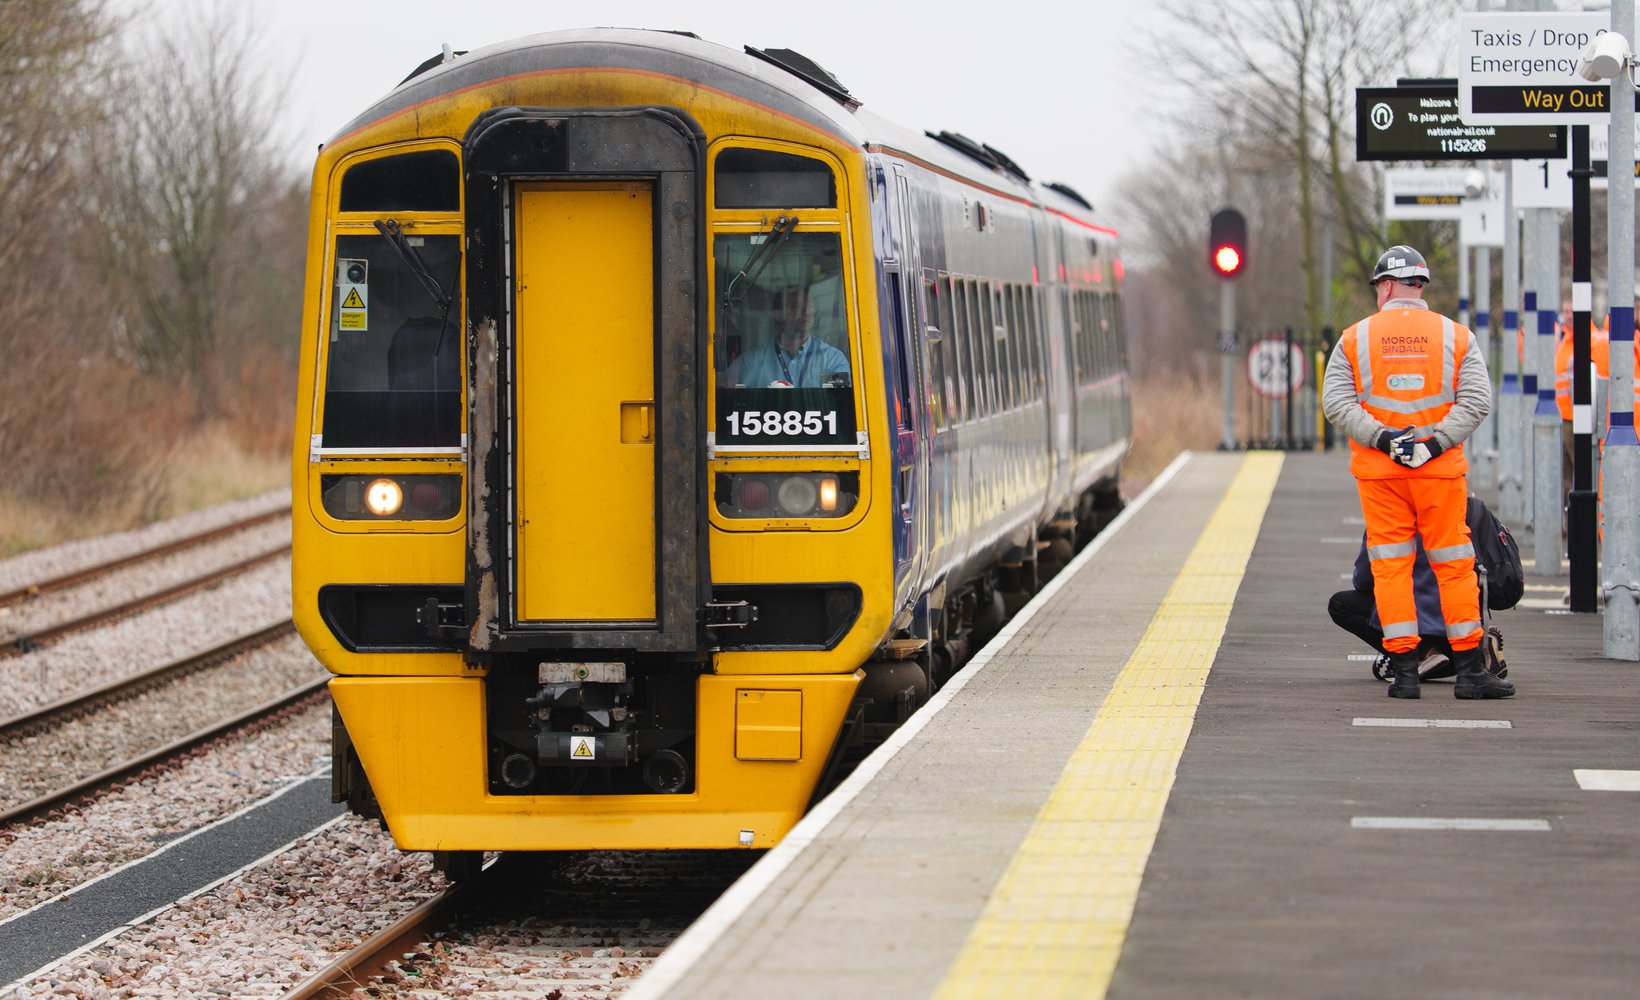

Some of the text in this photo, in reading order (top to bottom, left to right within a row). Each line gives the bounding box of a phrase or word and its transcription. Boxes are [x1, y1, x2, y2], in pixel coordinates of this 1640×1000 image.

[1471, 29, 1522, 47] Taxis
[1543, 29, 1589, 49] Drop
[1471, 56, 1578, 76] Emergency
[1420, 98, 1452, 108] Welcome
[1522, 89, 1604, 112] Way Out
[1408, 112, 1419, 122] To
[1420, 113, 1438, 124] plan
[1427, 126, 1496, 136] nationalrail.co.uk
[1381, 336, 1428, 345] MORGAN
[1382, 345, 1426, 354] SINDALL
[726, 410, 837, 436] 158851
